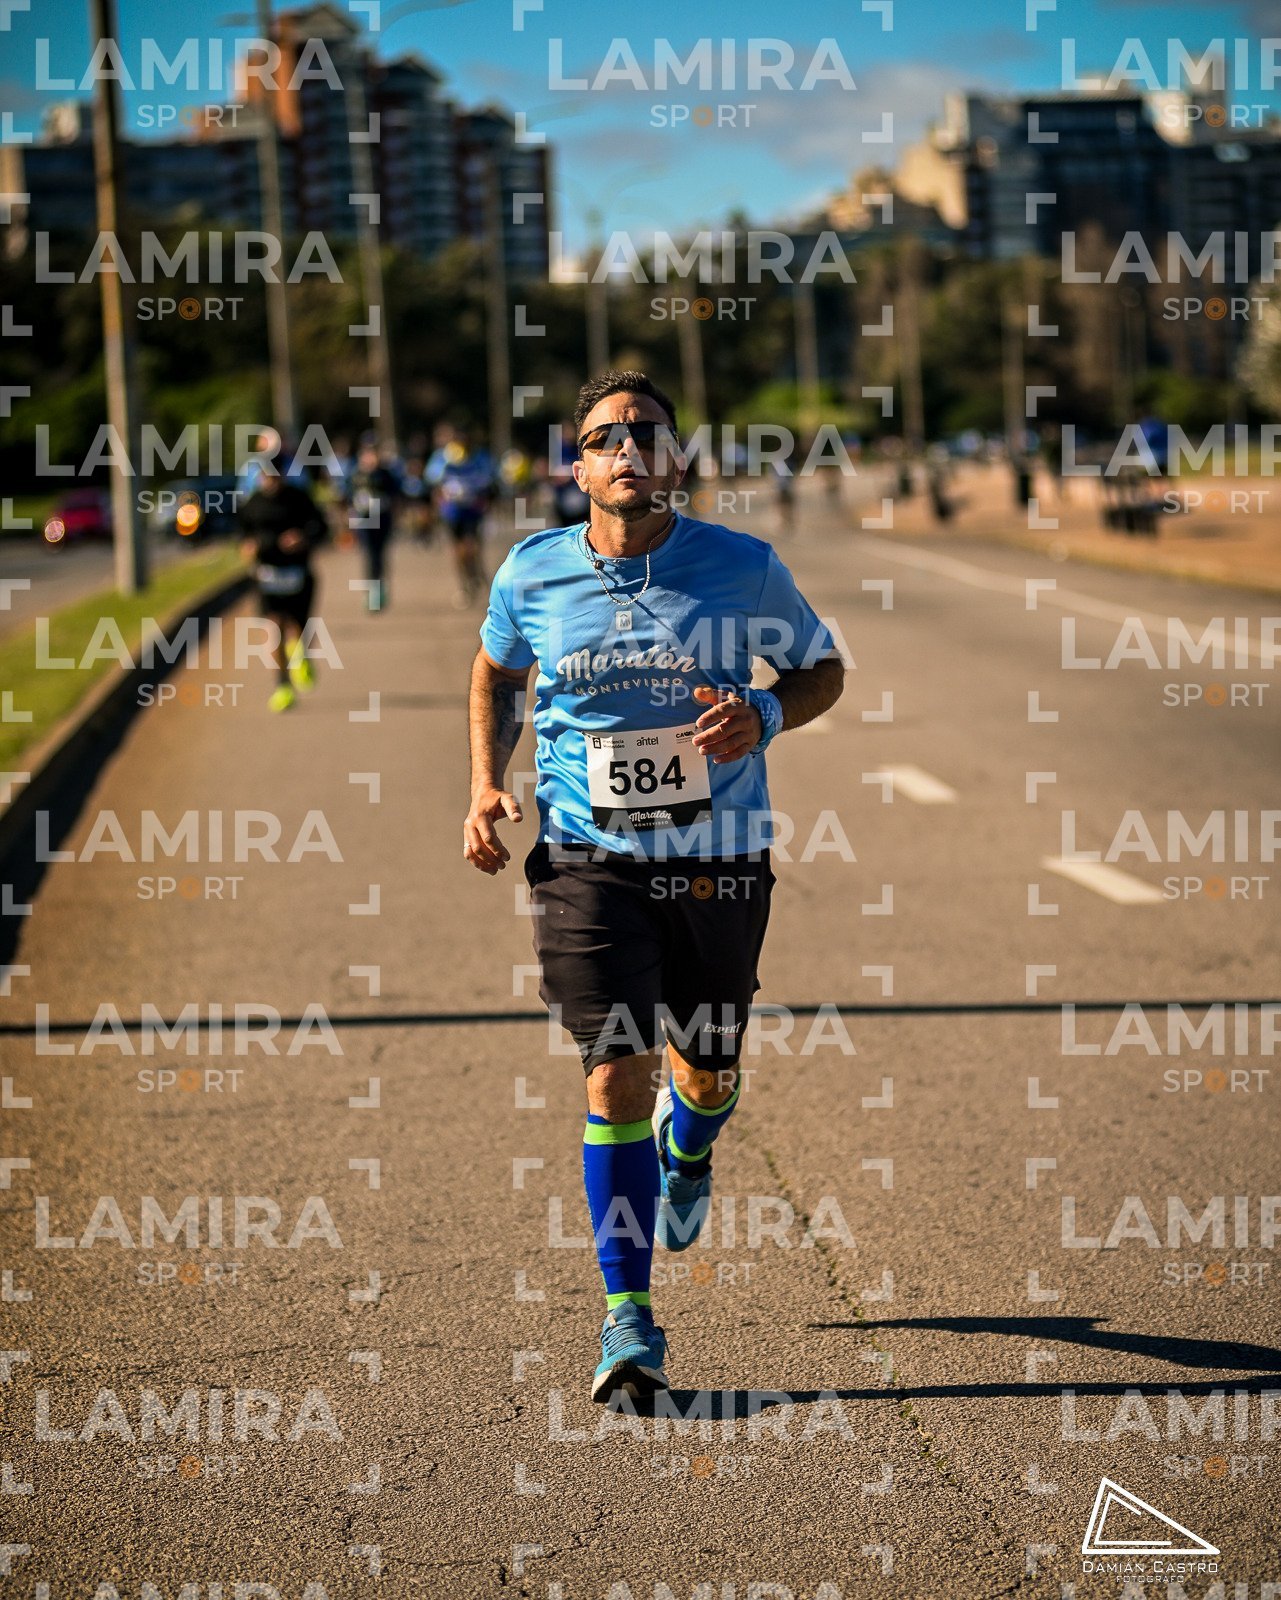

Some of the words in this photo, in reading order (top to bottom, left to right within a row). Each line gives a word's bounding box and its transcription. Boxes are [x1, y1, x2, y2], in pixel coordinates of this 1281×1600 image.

[556, 644, 696, 682] Maratón
[575, 677, 684, 698] MONTEVIDEO
[636, 736, 659, 747] antel
[609, 755, 686, 795] 584
[629, 809, 672, 822] Maratón
